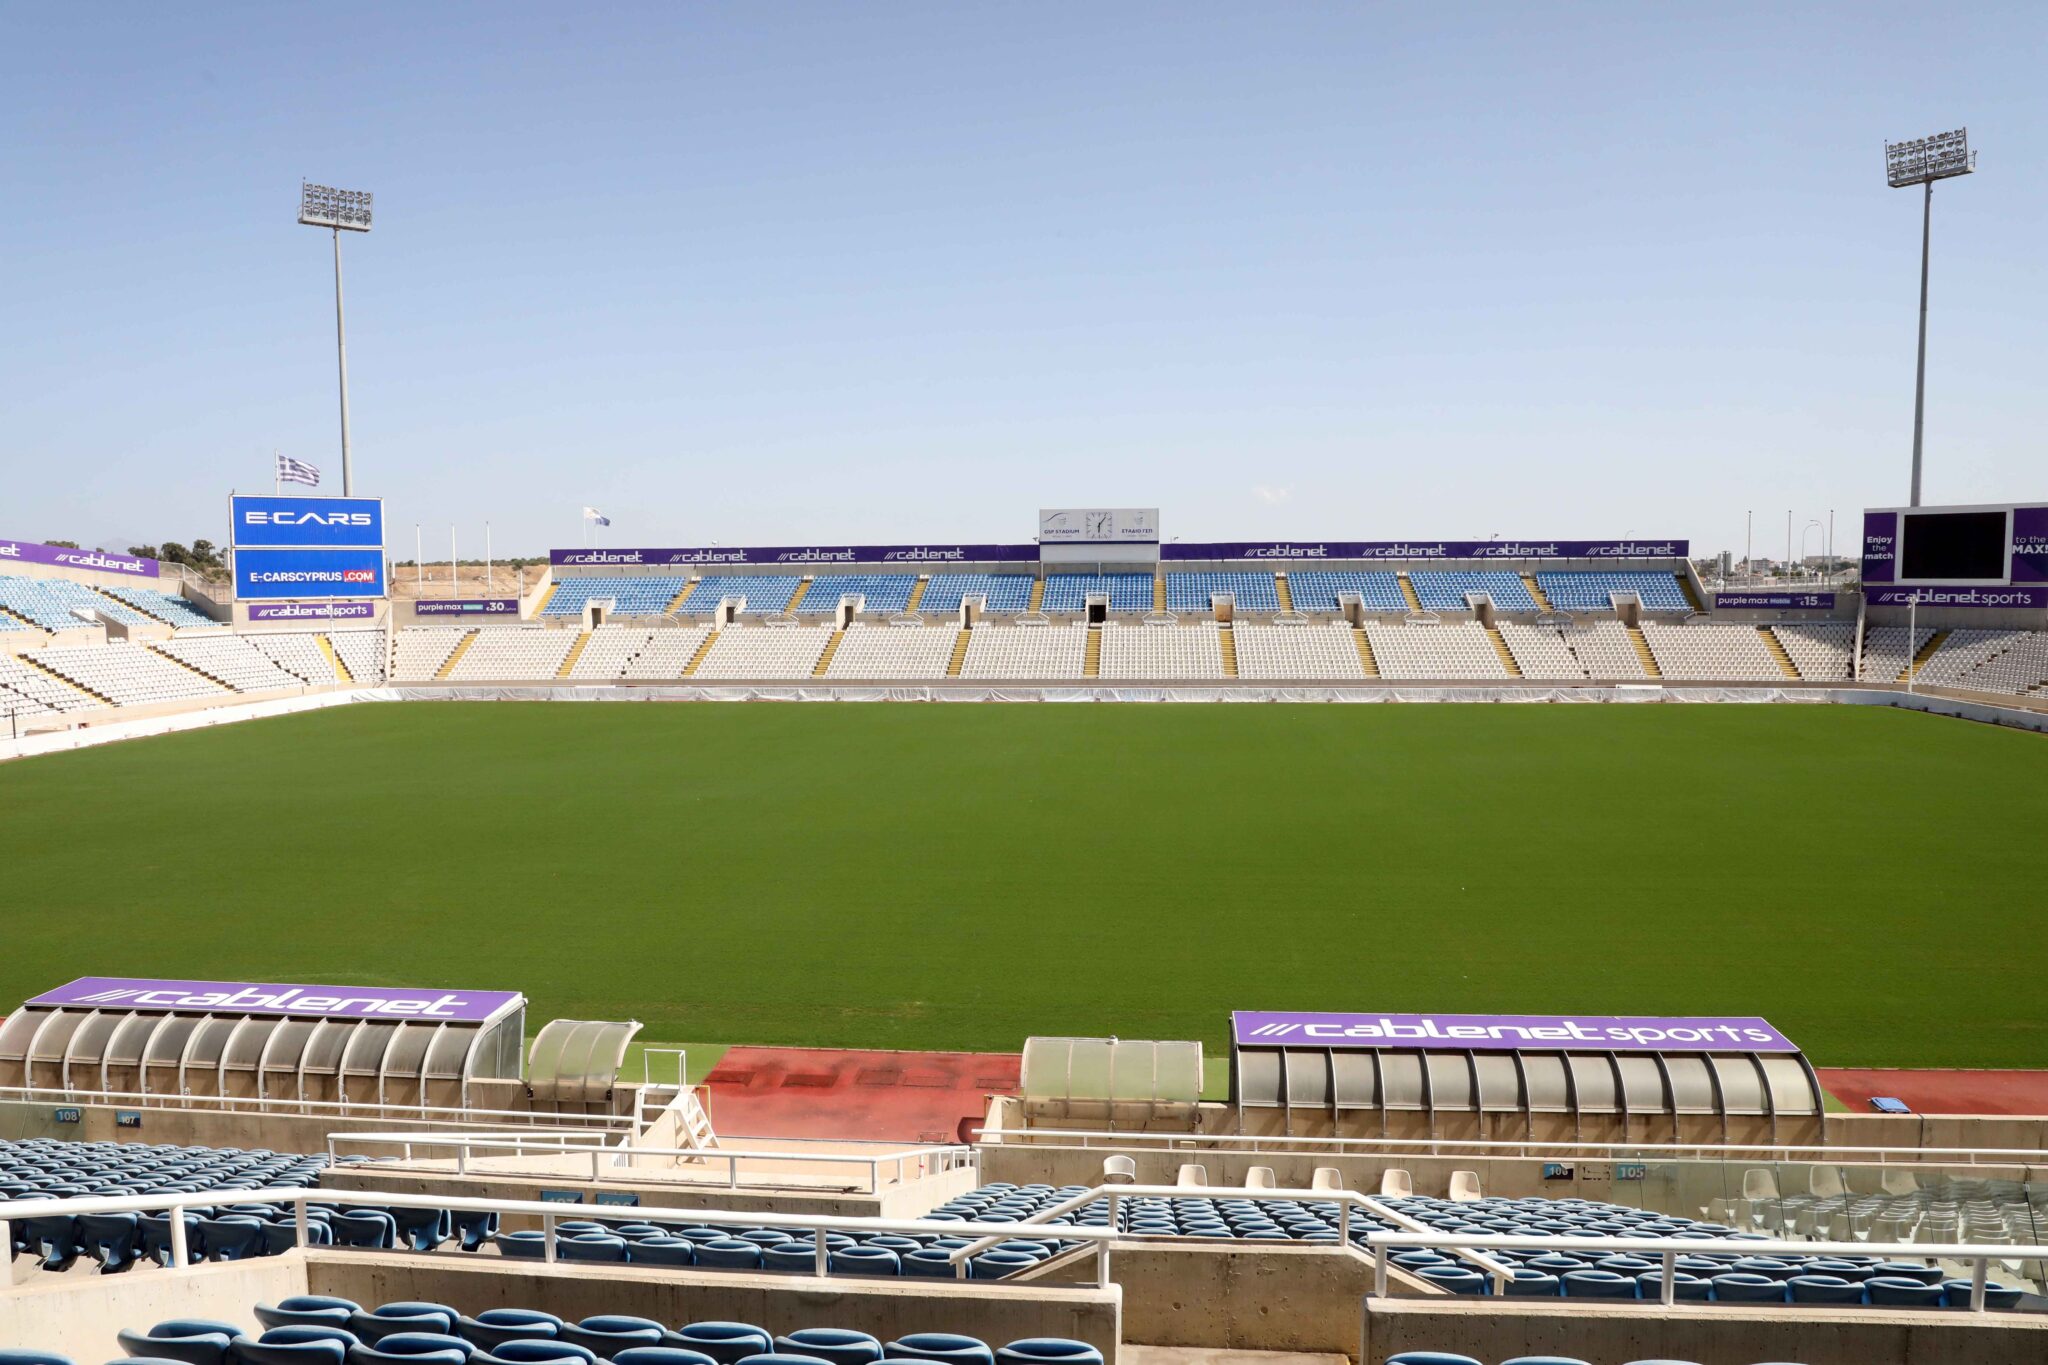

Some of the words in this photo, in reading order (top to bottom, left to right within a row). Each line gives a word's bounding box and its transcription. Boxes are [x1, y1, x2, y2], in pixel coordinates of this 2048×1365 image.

[245, 511, 372, 525] E-CARS
[1866, 536, 1893, 544] Enjoy
[2015, 536, 2027, 544] to
[2029, 535, 2047, 544] the
[789, 548, 856, 561] cablenet
[896, 547, 964, 560] cablenet
[1257, 544, 1328, 557] cablenet
[1375, 543, 1446, 556] cablenet
[1486, 543, 1559, 556] cablenet
[1600, 542, 1676, 555] cablenet
[575, 551, 643, 563] cablenet
[682, 549, 747, 562] cablenet
[1864, 552, 1894, 560] match
[69, 553, 145, 572] cablenet
[1718, 597, 1747, 605] purple
[1981, 591, 2032, 606] sports
[418, 603, 444, 612] purple
[133, 987, 469, 1016] cablenet
[1303, 1018, 1606, 1041] cablenet
[1605, 1025, 1773, 1045] sports
[58, 1111, 78, 1121] 108
[121, 1115, 135, 1124] 107
[1621, 1167, 1644, 1178] 105
